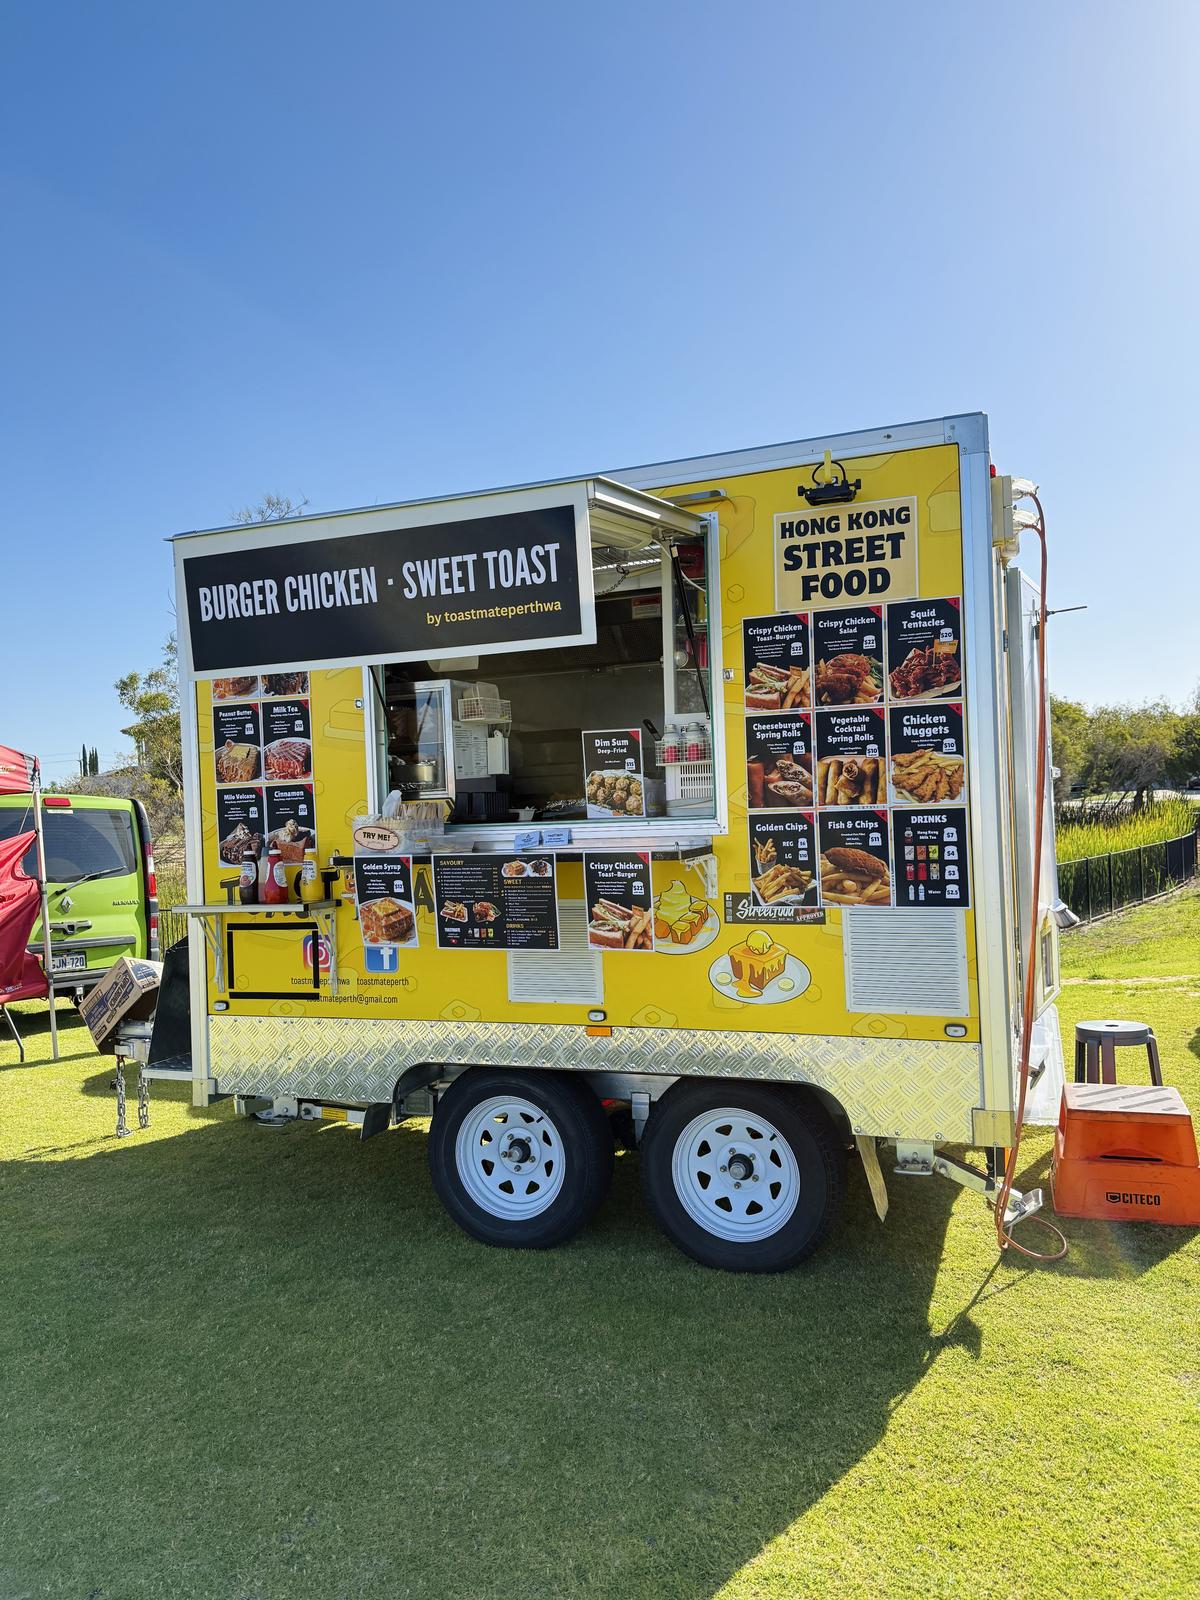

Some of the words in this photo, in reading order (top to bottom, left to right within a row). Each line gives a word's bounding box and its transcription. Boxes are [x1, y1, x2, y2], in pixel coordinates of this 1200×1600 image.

[780, 516, 840, 539] HONG
[848, 506, 910, 530] KONG
[784, 532, 905, 572] STREET
[198, 579, 280, 622] BURGER
[284, 566, 378, 612] CHICKEN
[402, 554, 478, 600] SWEET
[482, 543, 560, 590] TOAST
[801, 567, 891, 602] FOOD
[426, 612, 442, 626] by
[444, 599, 562, 622] toastmateperthwa
[910, 609, 936, 620] Squid
[818, 620, 844, 628] Crispy
[845, 617, 876, 625] Chicken
[902, 619, 945, 629] Tentacles
[748, 627, 772, 635] Crispy
[773, 624, 802, 632] Chicken
[830, 715, 870, 725] Vegetable
[903, 714, 946, 725] Chicken
[753, 722, 804, 730] Cheeseburger
[834, 725, 866, 733] Cocktail
[756, 731, 781, 740] Spring
[903, 726, 949, 737] Nuggets
[827, 735, 853, 744] Spring
[855, 820, 878, 829] Chips
[911, 815, 947, 824] DRINKS
[785, 823, 808, 832] Chips
[590, 862, 613, 871] Crispy
[357, 978, 408, 987] toastmateperth
[1122, 1193, 1160, 1206] CITECO
